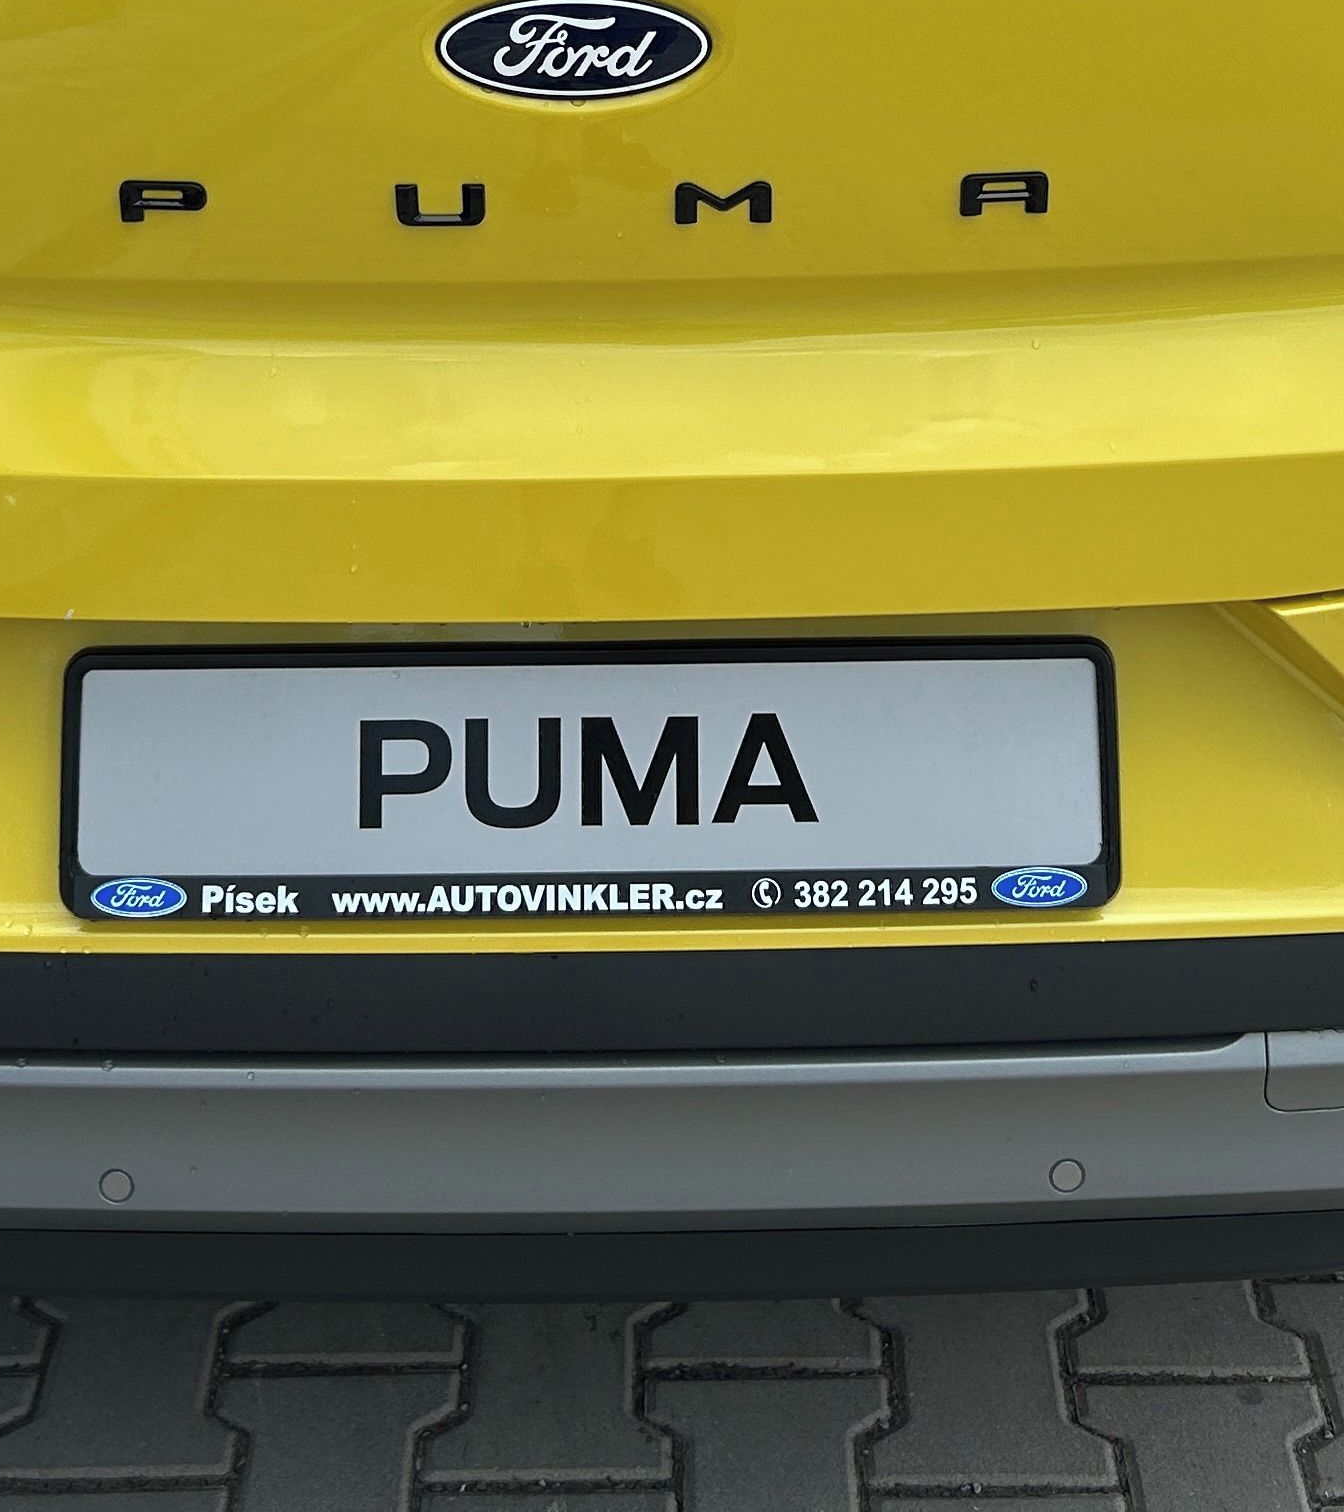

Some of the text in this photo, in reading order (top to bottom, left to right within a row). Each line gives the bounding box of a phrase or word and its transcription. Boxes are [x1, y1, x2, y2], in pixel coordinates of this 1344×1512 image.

[493, 14, 657, 78] Ford
[118, 171, 1050, 227] PUMA
[358, 712, 819, 829] PUMA
[110, 884, 164, 909] Ford
[201, 877, 978, 914] Písek www.AUTOVINKLER.cz 382 214 295
[1011, 874, 1067, 899] Ford
